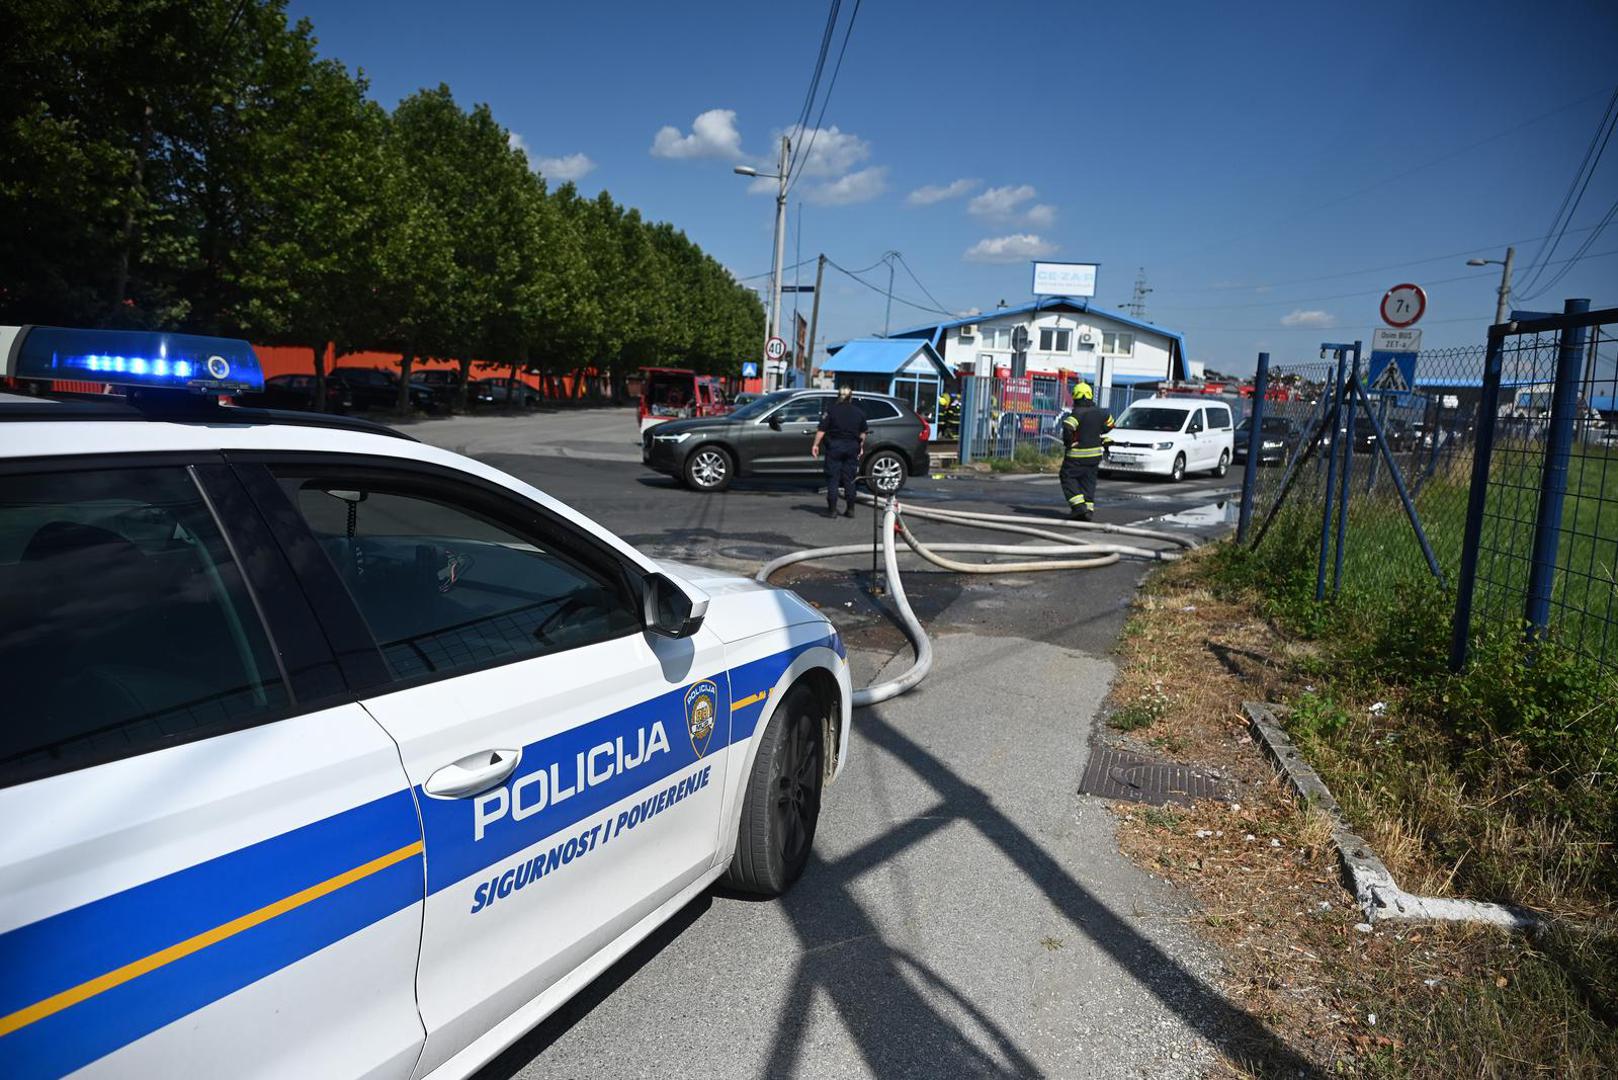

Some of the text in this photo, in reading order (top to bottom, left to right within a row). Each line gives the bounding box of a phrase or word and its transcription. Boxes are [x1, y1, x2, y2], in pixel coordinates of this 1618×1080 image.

[769, 342, 781, 354] 40
[687, 685, 715, 704] POLICIJA
[474, 720, 670, 841] POLICIJA
[471, 765, 712, 914] SIGURNOST I POVJERENJE
